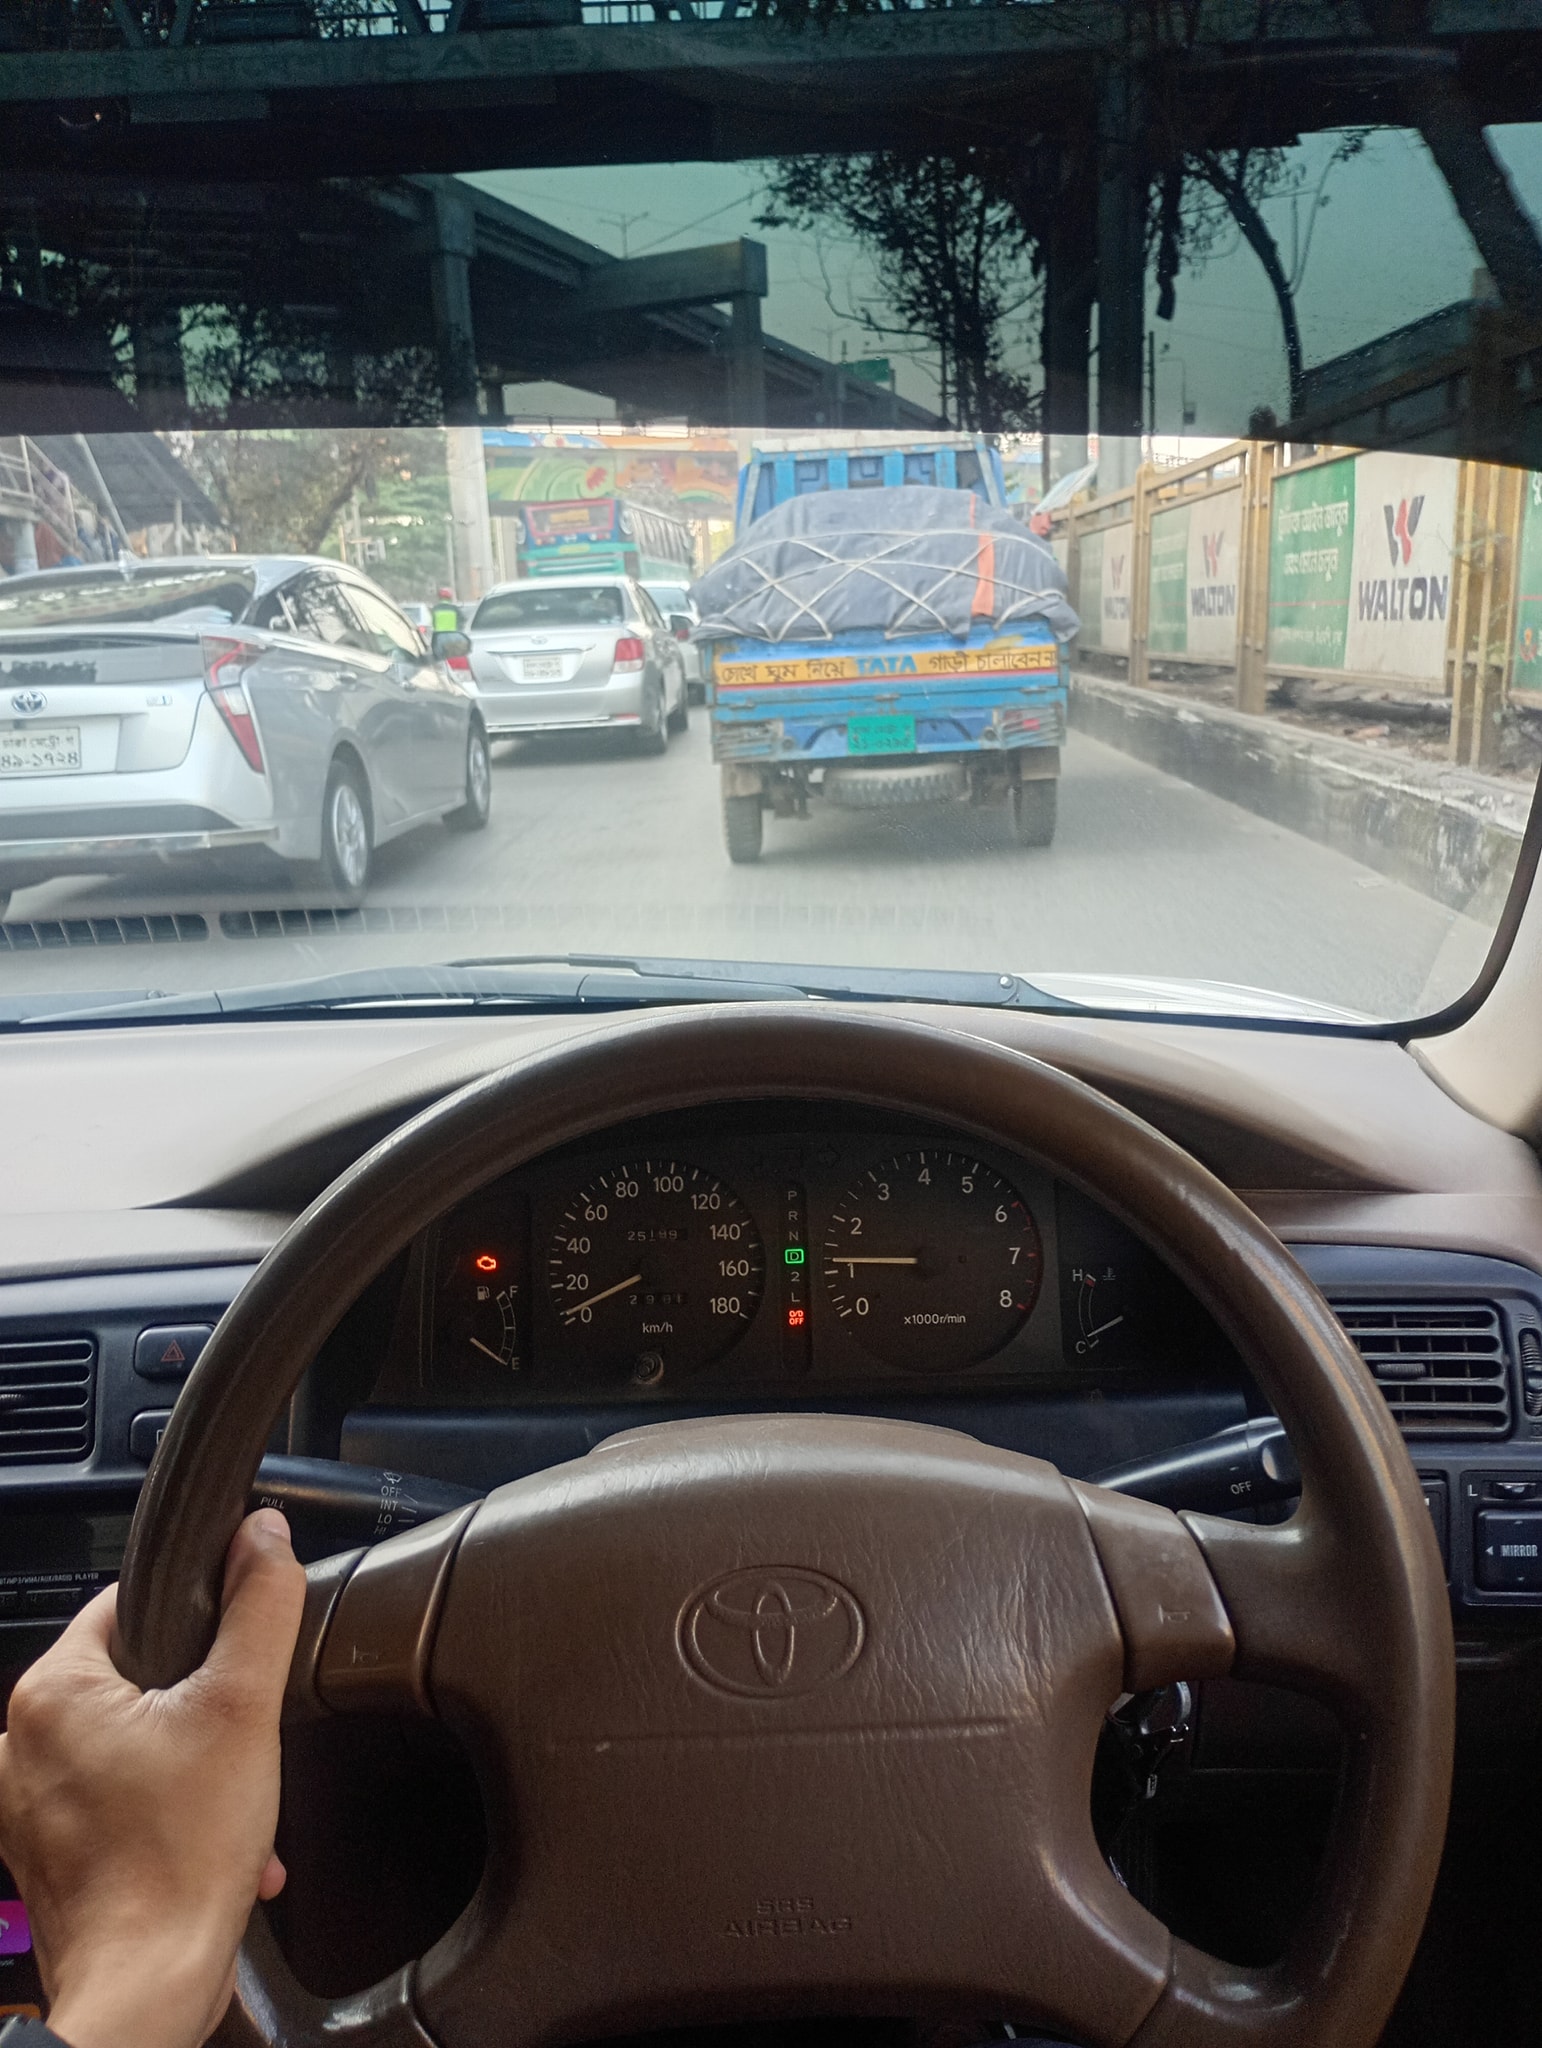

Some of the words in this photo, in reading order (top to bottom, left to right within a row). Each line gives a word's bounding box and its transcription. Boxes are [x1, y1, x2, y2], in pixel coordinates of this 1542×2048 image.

[1190, 585, 1236, 617] WALTON
[1358, 575, 1448, 622] WALTON
[721, 663, 759, 682] চোখে
[765, 664, 799, 682] ঘুম
[806, 658, 847, 678] নিয়ে
[855, 655, 918, 676] TATA
[653, 1177, 685, 1194] 100
[917, 1169, 932, 1186] 4
[961, 1177, 974, 1195] 5
[615, 1181, 640, 1199] 80
[788, 1190, 798, 1201] P
[877, 1183, 891, 1201] 3
[691, 1194, 721, 1211] 120
[584, 1204, 609, 1222] 60
[788, 1210, 799, 1221] R
[994, 1205, 1008, 1223] 6
[709, 1223, 742, 1241] 140
[850, 1218, 863, 1235] 2
[788, 1231, 799, 1241] N
[566, 1237, 591, 1254] 40
[789, 1252, 800, 1261] D
[1008, 1247, 1021, 1265] 7
[718, 1259, 750, 1277] 160
[790, 1271, 801, 1282] 2
[846, 1262, 855, 1279] 1
[1072, 1269, 1084, 1283] H
[566, 1274, 590, 1291] 20
[509, 1285, 519, 1299] F
[791, 1292, 801, 1302] L
[999, 1290, 1013, 1308] 8
[709, 1297, 741, 1315] 180
[856, 1298, 870, 1316] 0
[580, 1307, 593, 1324] 0
[788, 1317, 804, 1326] OFF
[642, 1321, 674, 1335] km/h
[1075, 1341, 1086, 1354] C
[511, 1357, 520, 1371] E
[381, 1485, 403, 1498] OFF
[1230, 1481, 1252, 1495] OFF
[1467, 1484, 1478, 1497] L
[260, 1496, 285, 1509] PULL
[380, 1499, 399, 1511] INT
[377, 1513, 393, 1525] LO
[373, 1525, 387, 1536] HI
[1501, 1544, 1539, 1557] MIRROR
[74, 1572, 100, 1582] PLAYER
[722, 1915, 855, 1939] AIRBAG
